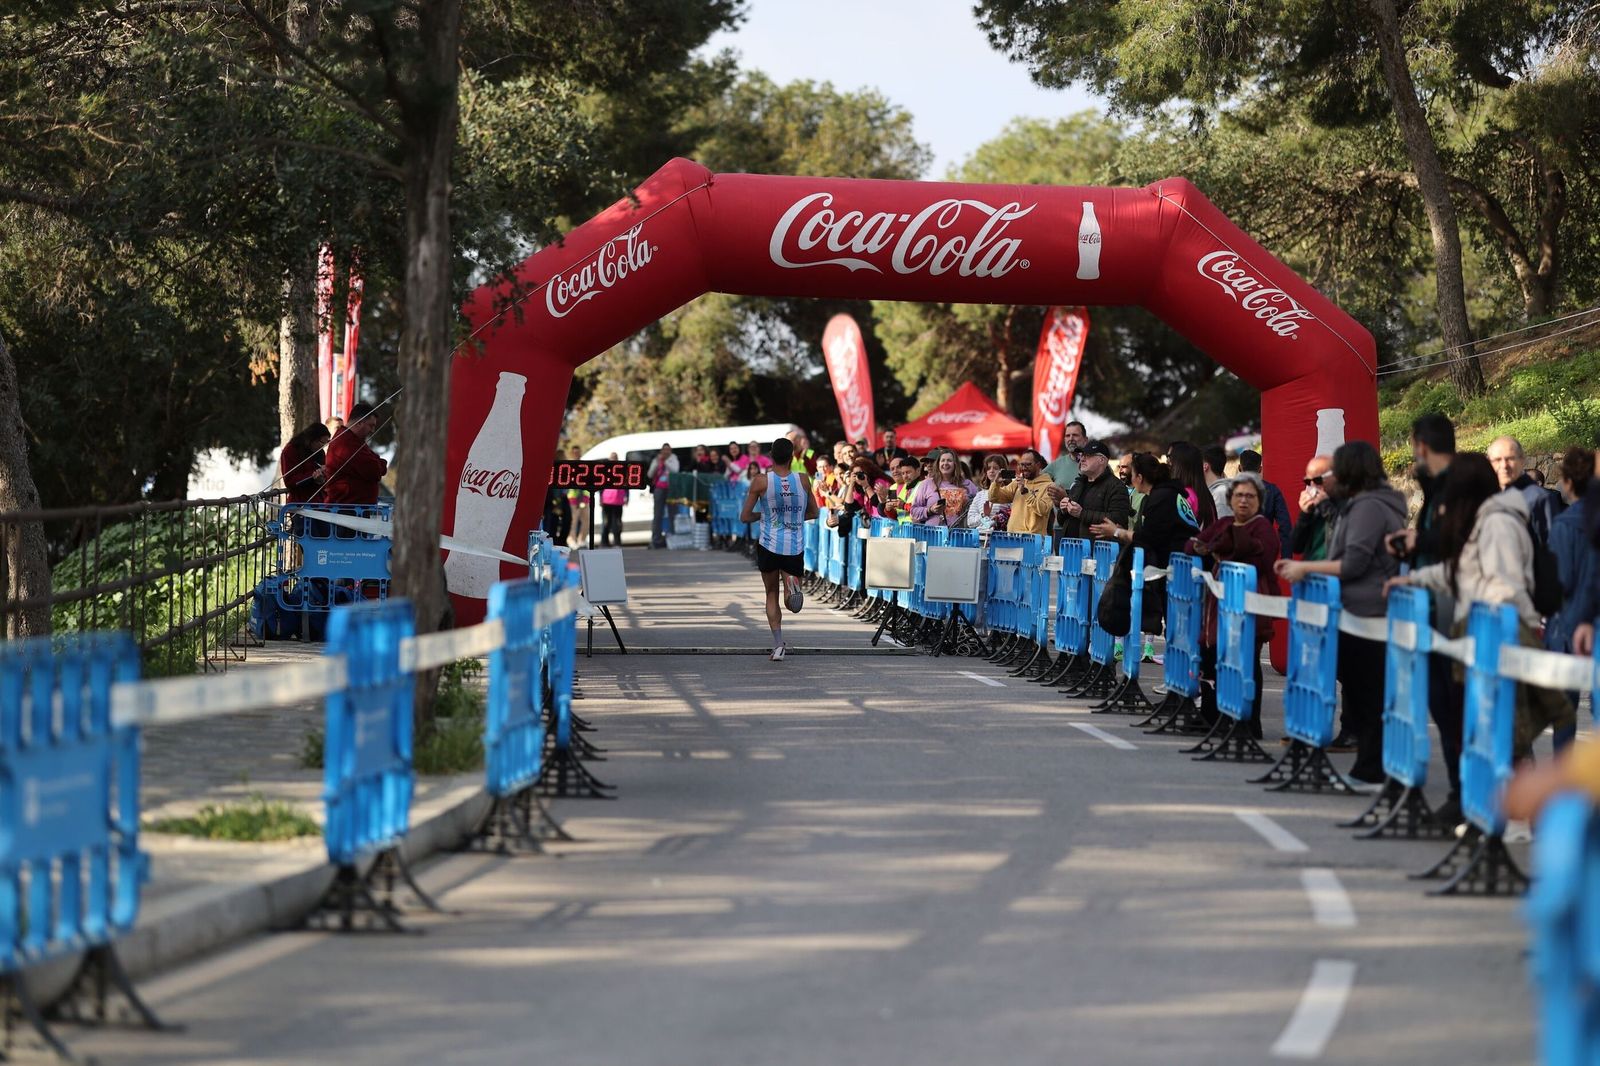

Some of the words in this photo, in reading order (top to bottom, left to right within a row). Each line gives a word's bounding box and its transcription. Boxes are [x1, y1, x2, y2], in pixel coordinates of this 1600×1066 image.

[545, 222, 652, 318] Coca-Cola
[769, 192, 1037, 278] Coca-Cola
[1197, 250, 1315, 337] Coca-Cola
[461, 463, 519, 498] Coca-Cola
